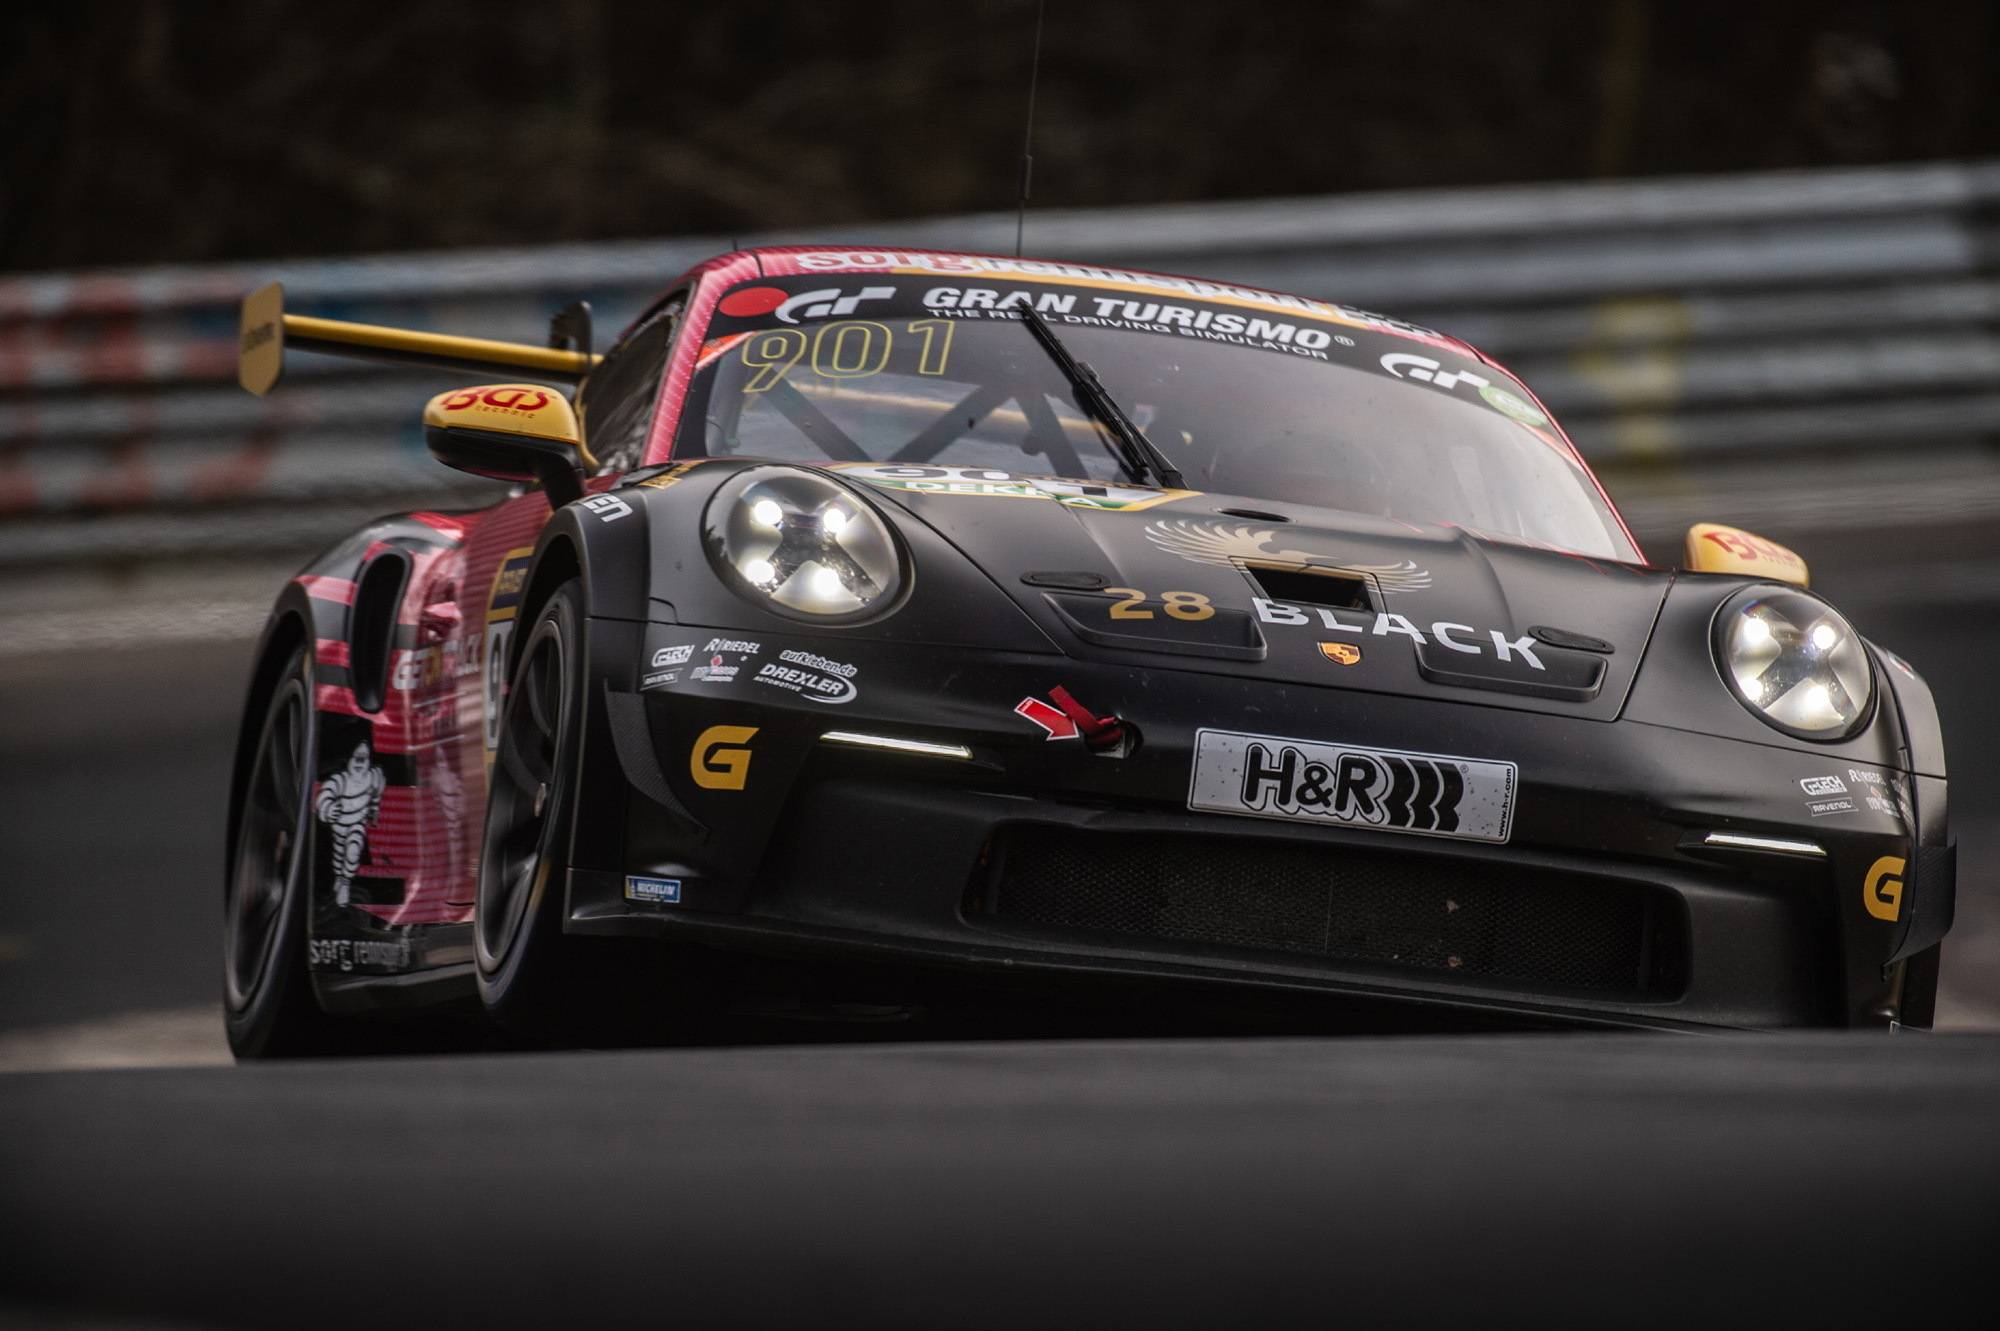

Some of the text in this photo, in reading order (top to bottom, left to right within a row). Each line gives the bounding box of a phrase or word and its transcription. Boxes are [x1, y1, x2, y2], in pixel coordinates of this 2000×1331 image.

[922, 287, 1077, 314] GRAN
[740, 318, 956, 393] 901
[928, 309, 1329, 361] THE REL DRIVING SIMULATOR
[1104, 587, 1216, 622] 28
[1252, 597, 1547, 671] BLACK
[752, 676, 803, 692] AUTOMOTIVE
[759, 663, 844, 695] DREXLER
[779, 649, 859, 678] aufkleben.de
[690, 724, 760, 790] G
[1242, 744, 1385, 822] H&R
[1498, 768, 1513, 837] www.h-r.com
[1863, 855, 1906, 922] G
